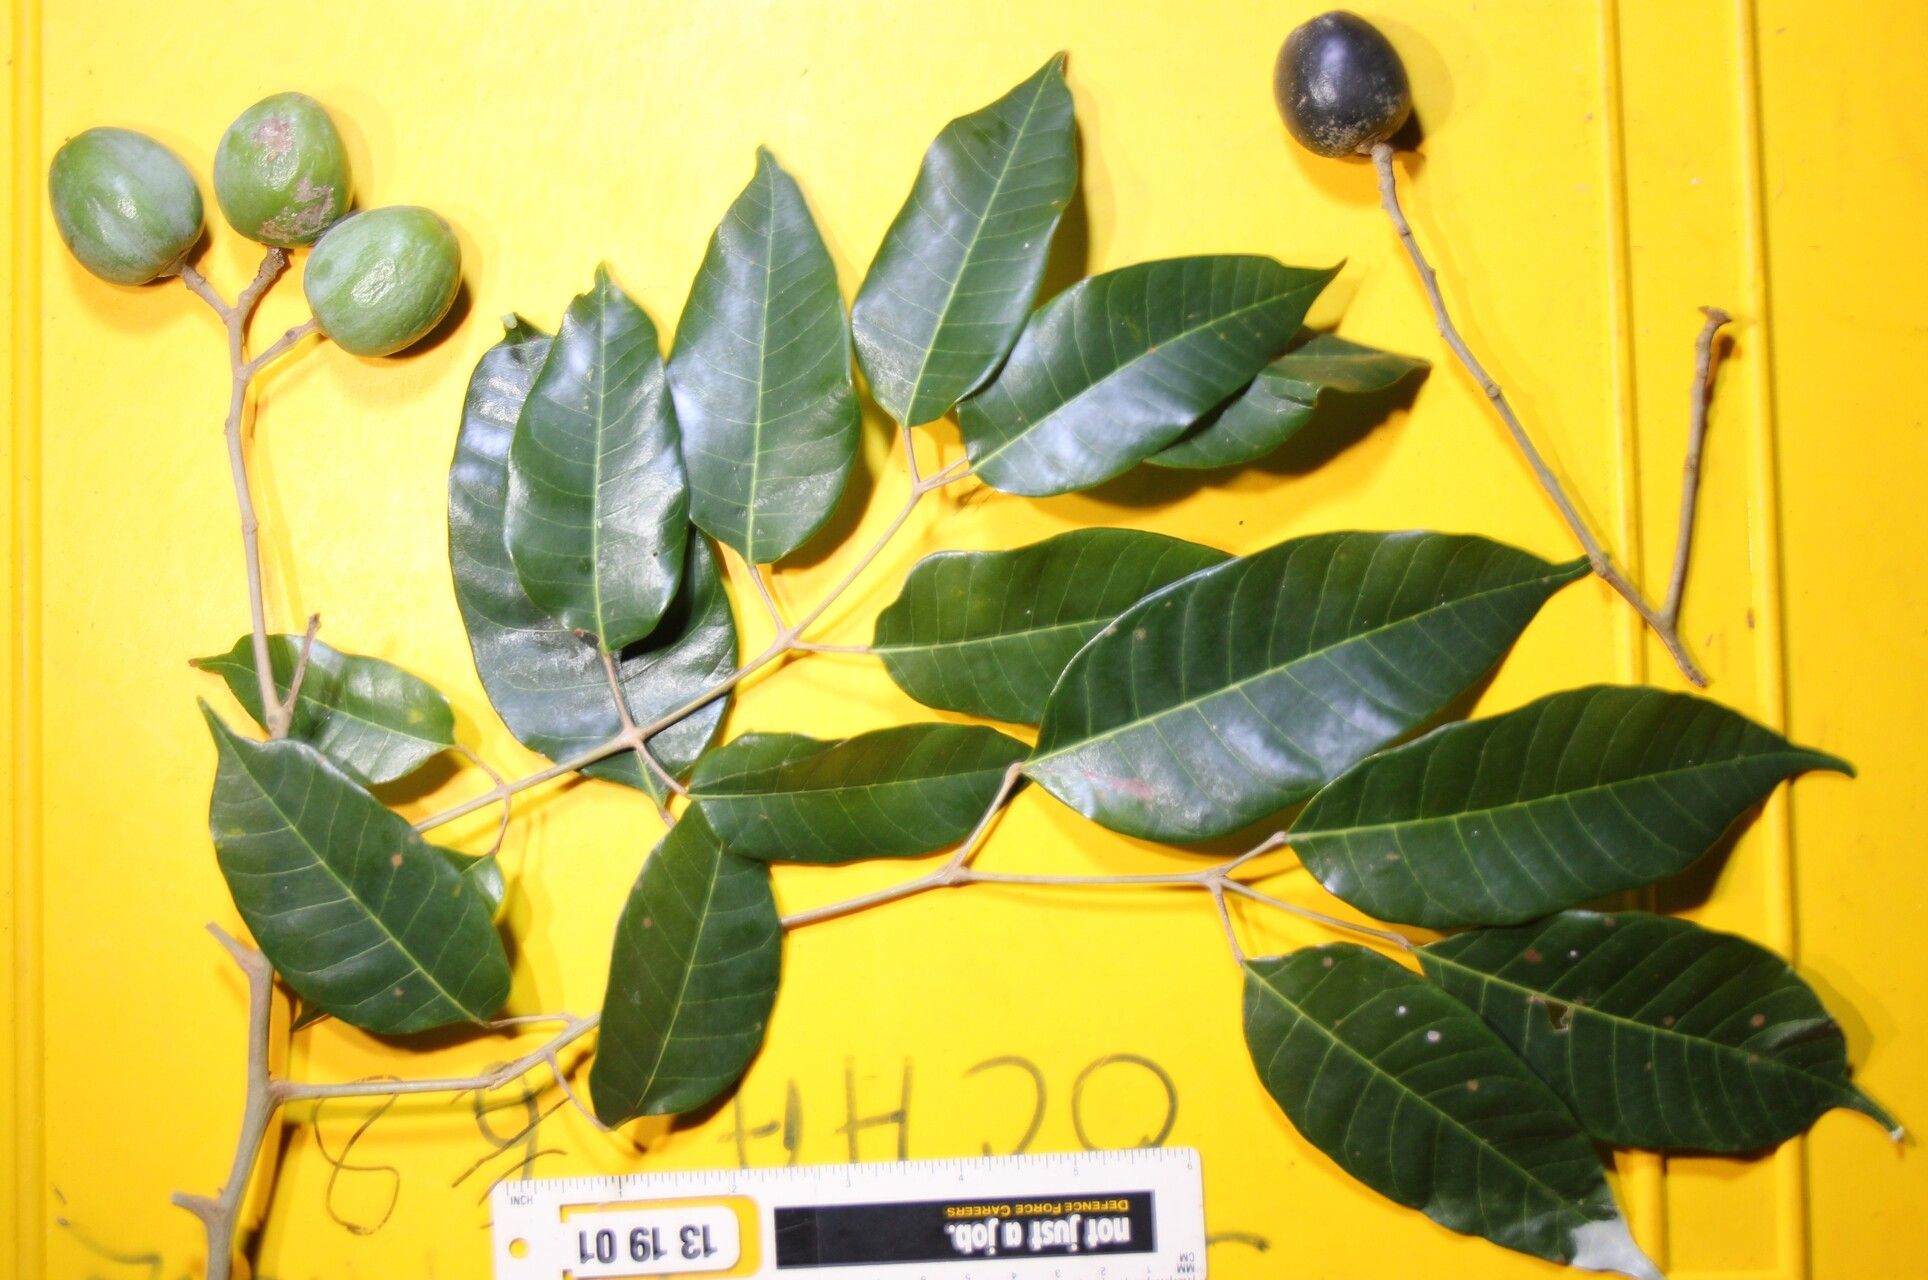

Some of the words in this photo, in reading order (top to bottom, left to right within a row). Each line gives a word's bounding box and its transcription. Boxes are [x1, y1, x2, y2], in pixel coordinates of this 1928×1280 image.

[510, 1195, 534, 1206] INCH
[947, 1204, 1011, 1217] CAREERS
[1016, 1202, 1062, 1214] FORCE
[1064, 1199, 1129, 1212] DEFENCE
[944, 1216, 999, 1255] job.
[1003, 1218, 1023, 1241] a
[1028, 1214, 1080, 1252] just
[1087, 1216, 1130, 1247] not
[578, 1228, 617, 1265] 01
[629, 1226, 668, 1263] 19
[680, 1224, 718, 1259] 13
[1176, 1263, 1195, 1273] MM
[1179, 1252, 1195, 1262] CM
